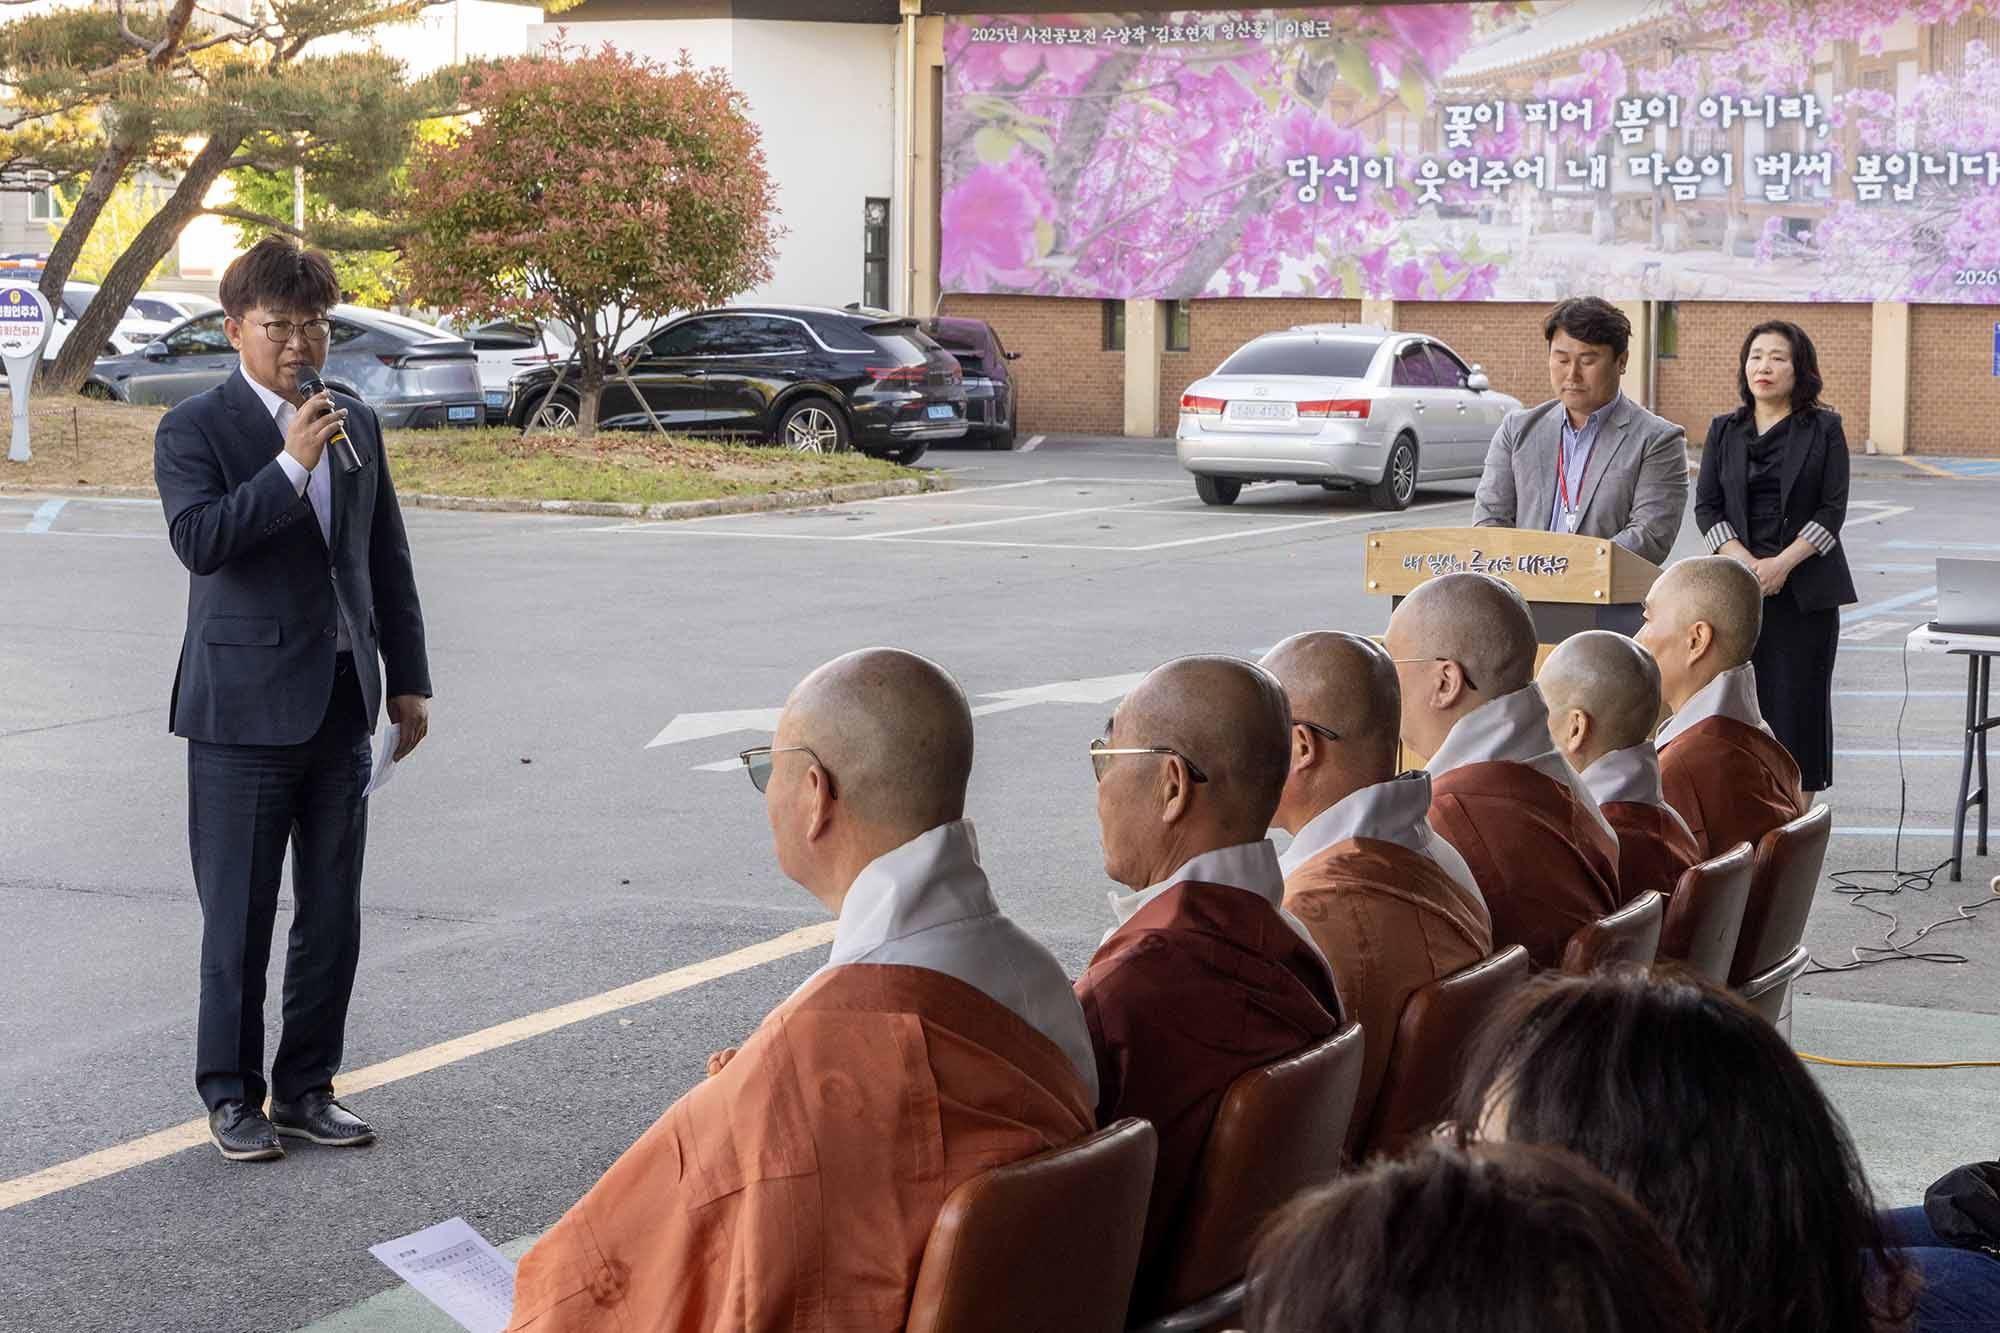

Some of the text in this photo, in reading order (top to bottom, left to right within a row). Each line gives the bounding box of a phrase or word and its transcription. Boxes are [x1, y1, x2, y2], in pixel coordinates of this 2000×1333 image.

[971, 25, 1018, 44] 2025년
[1022, 25, 1097, 45] 사진공모전
[1102, 25, 1147, 44] 수상작
[1285, 20, 1332, 39] 이현근
[1443, 94, 1830, 149] 꽃이 피어 봄이 아니라,
[1286, 151, 2000, 204] 당신이 웃어주어 내 마음이 벌써 봄입니다
[1954, 268, 2000, 286] 2026
[0, 304, 39, 318] 원인주차
[0, 325, 40, 337] 회전금지
[1402, 552, 1423, 573] 내
[1426, 552, 1467, 577] 일상이
[1517, 553, 1570, 577] 대덕구
